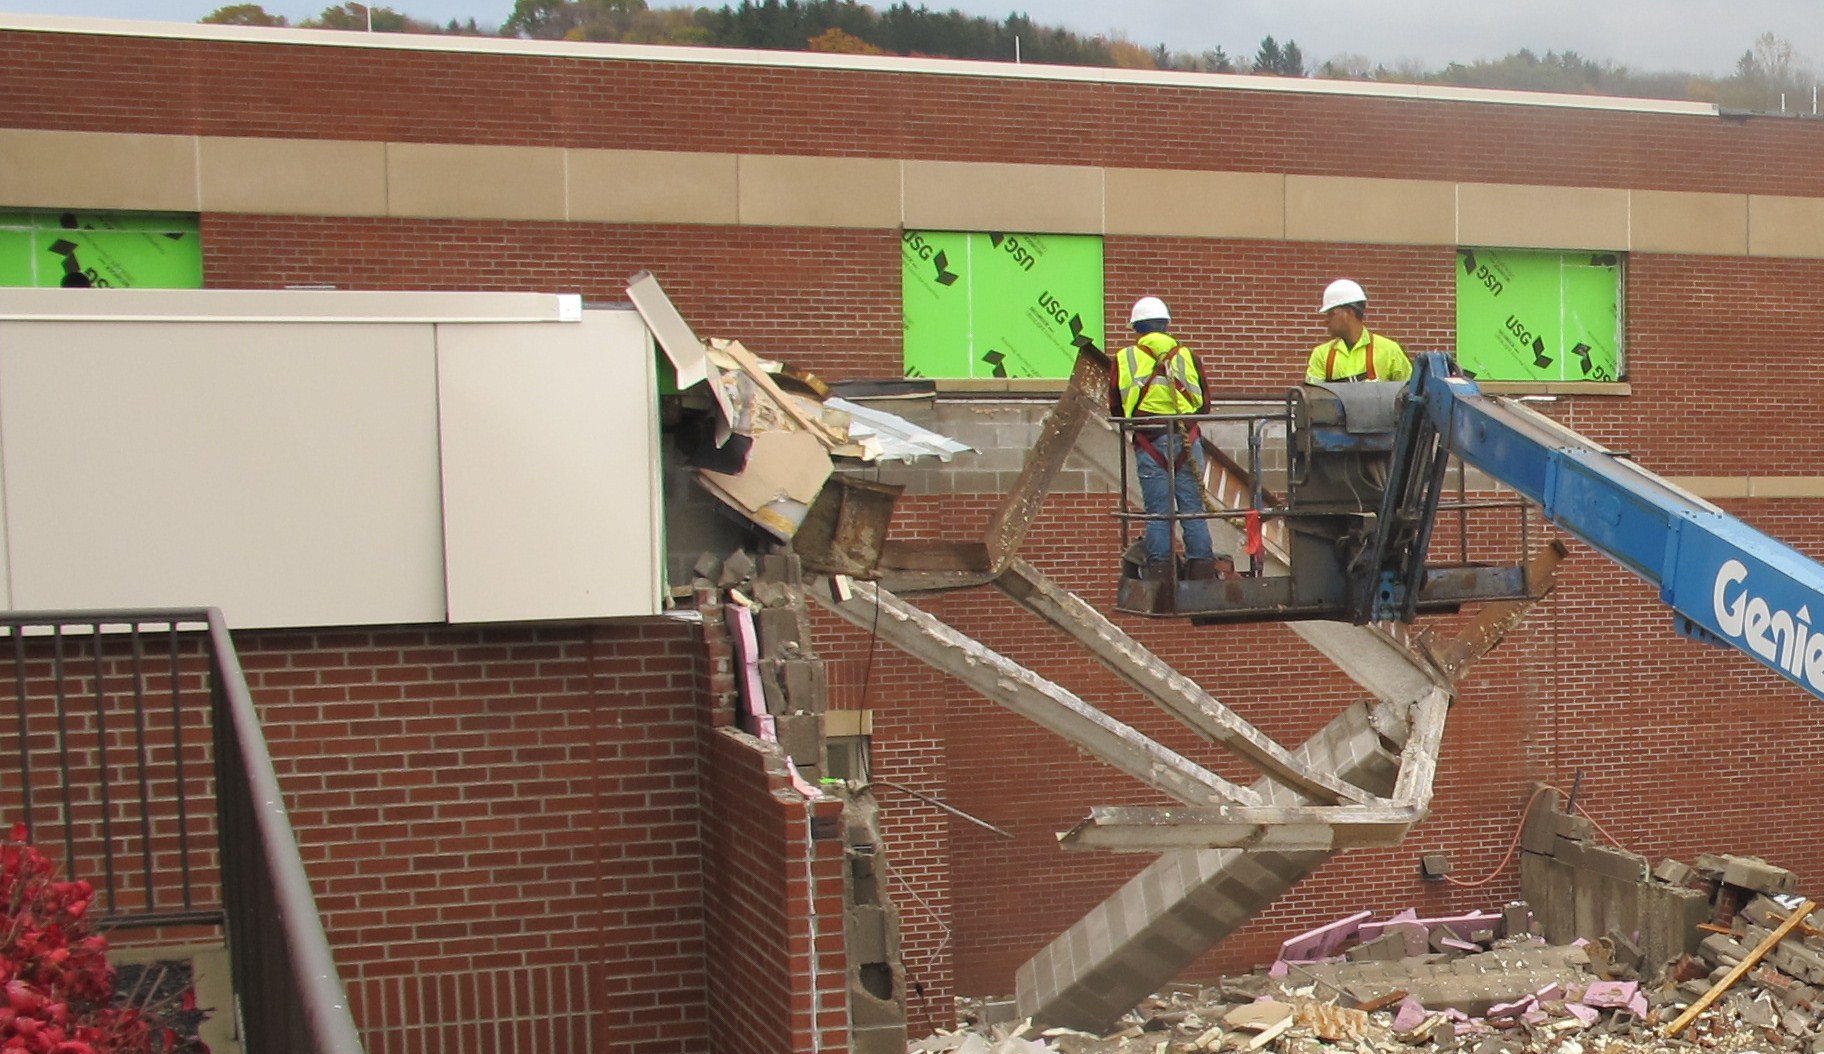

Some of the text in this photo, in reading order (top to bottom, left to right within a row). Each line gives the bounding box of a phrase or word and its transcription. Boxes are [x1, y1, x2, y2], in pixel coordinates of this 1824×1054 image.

[902, 231, 933, 261] USG
[1003, 236, 1036, 272] USG
[1475, 264, 1504, 297] USG
[1037, 290, 1069, 326] USG
[1504, 314, 1532, 347] USG
